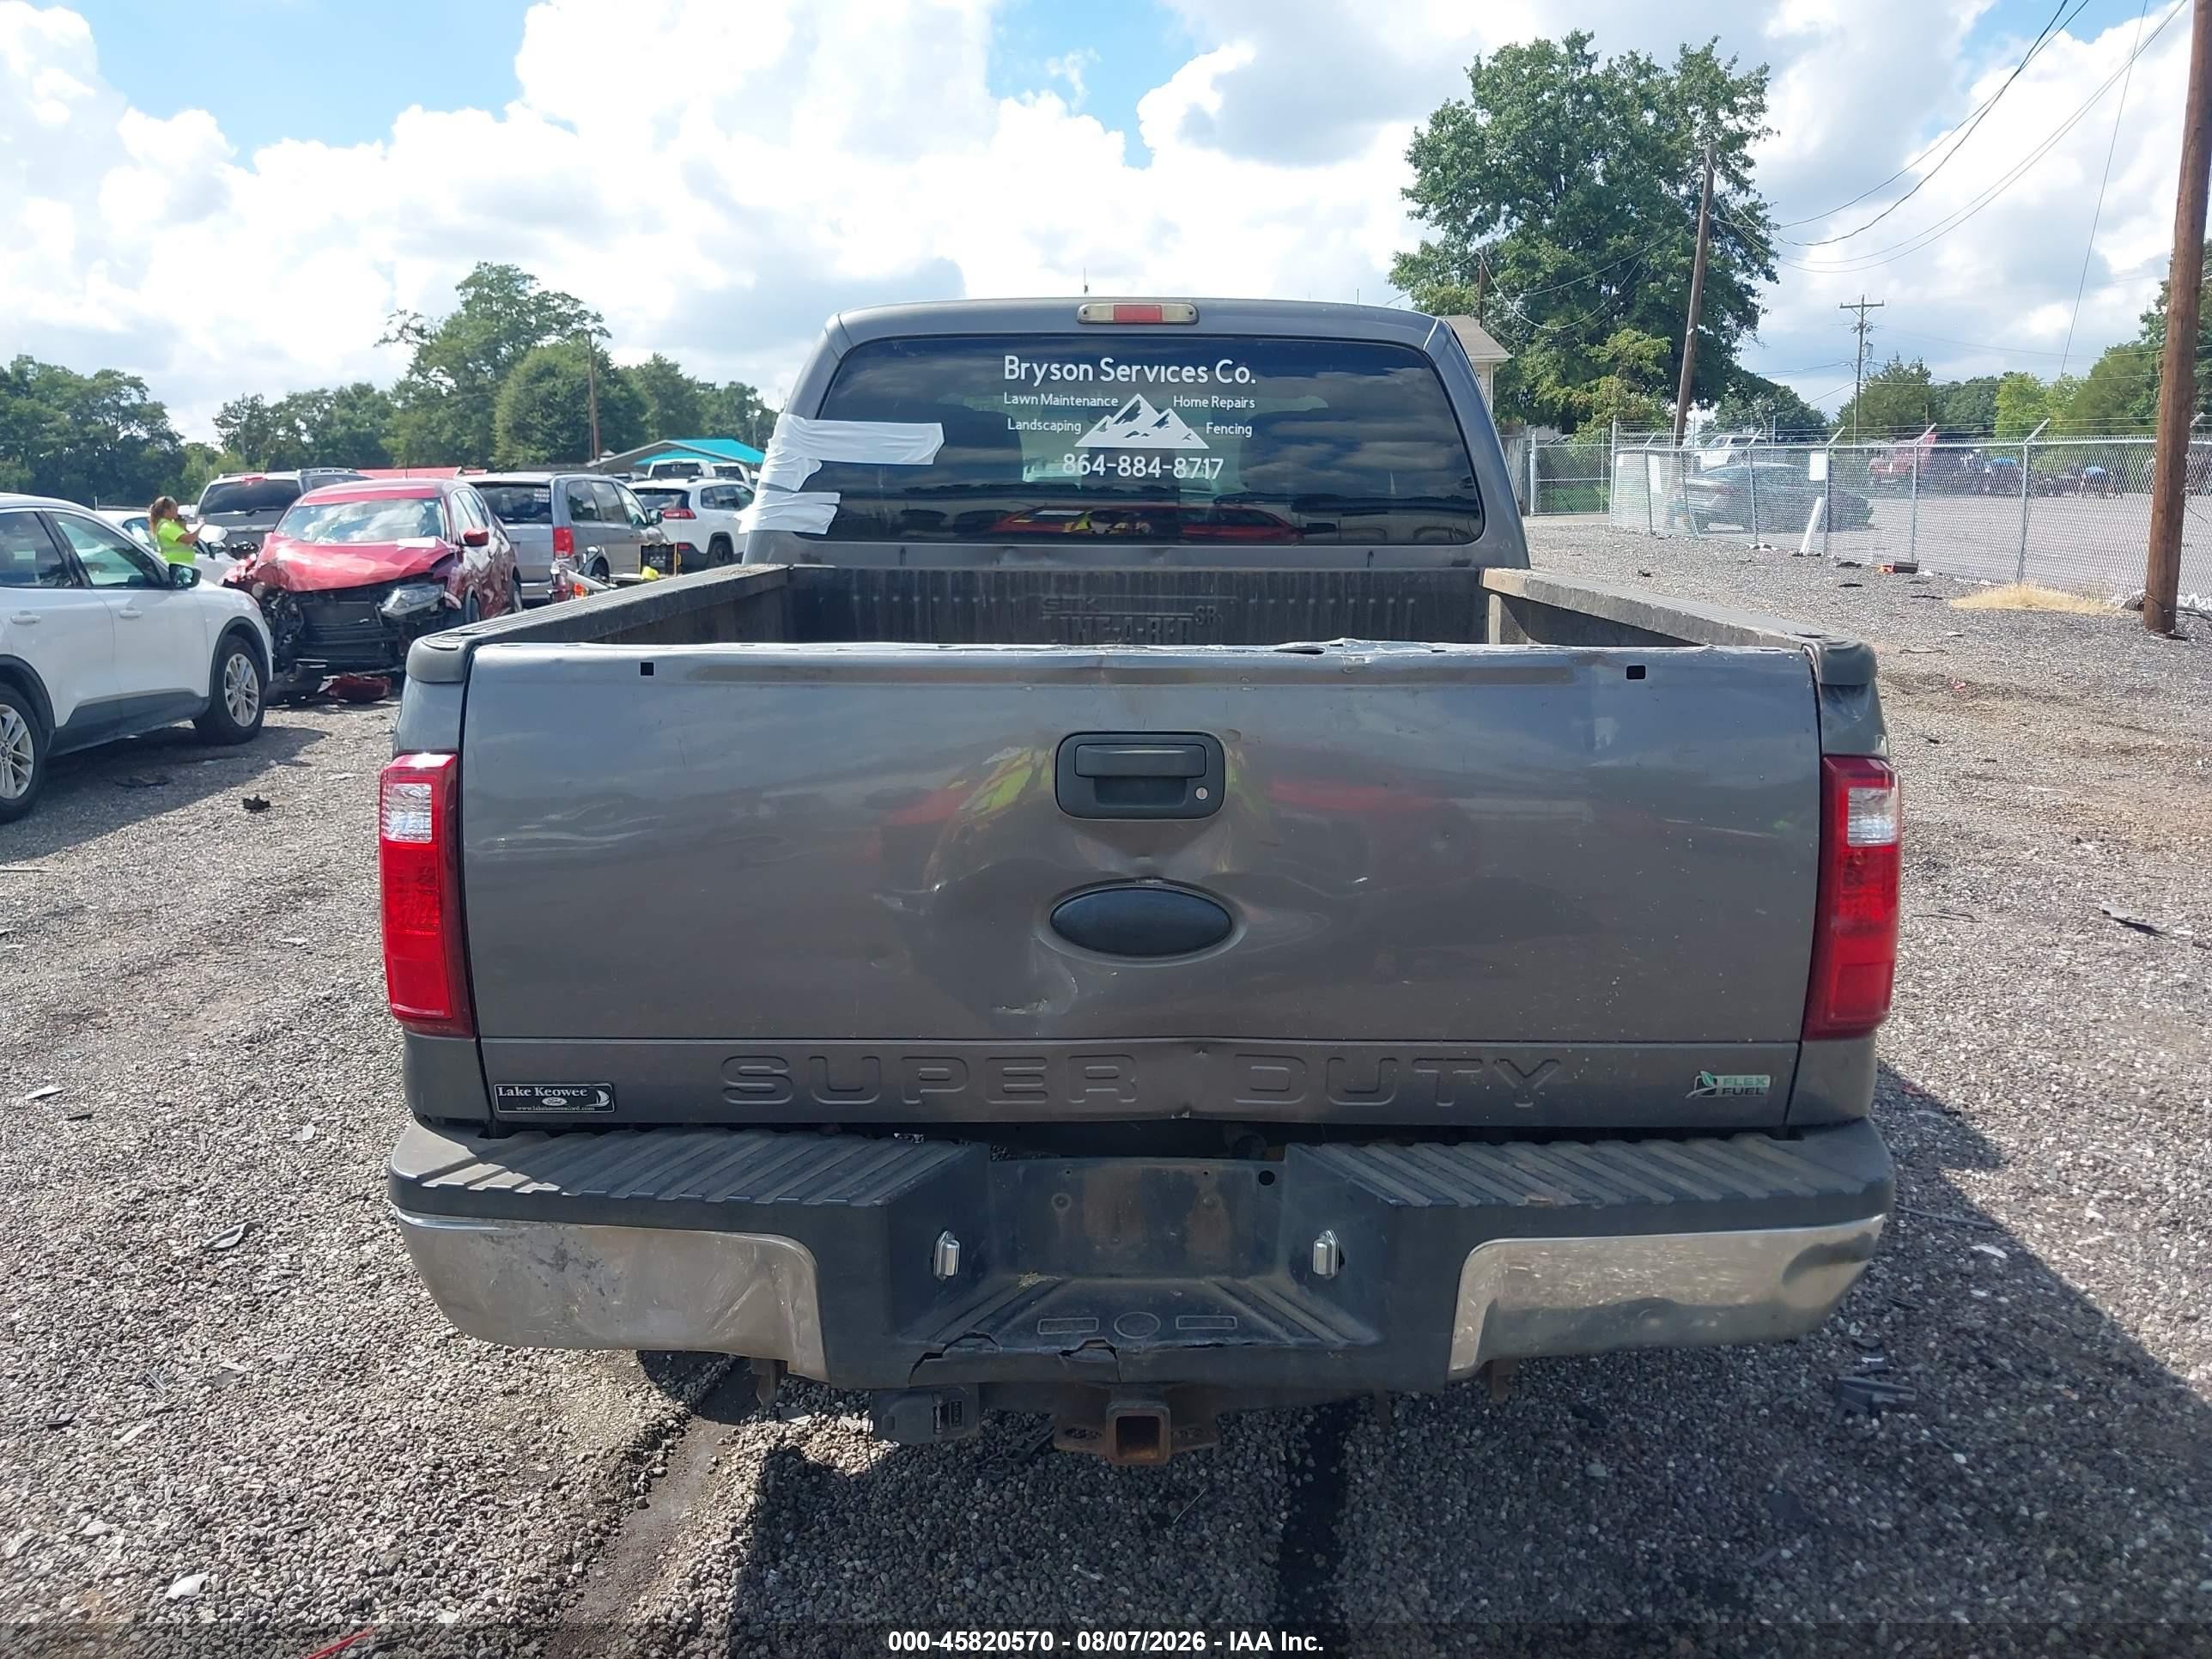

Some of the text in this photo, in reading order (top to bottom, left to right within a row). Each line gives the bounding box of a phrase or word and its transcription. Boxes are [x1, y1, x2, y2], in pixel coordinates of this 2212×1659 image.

[1004, 356, 1256, 386] Bryson Services Co.
[1004, 392, 1118, 407] Lawn Maintenance
[1173, 396, 1255, 410] Home Repairs
[1007, 418, 1082, 434] Landscaping
[1206, 422, 1252, 438] Fencing
[1062, 453, 1224, 479] 864-884-8717
[719, 1054, 1562, 1108] SUPER DUTY
[1723, 1078, 1766, 1086] FLEX
[497, 1086, 588, 1097] Lake Keowee
[1723, 1087, 1765, 1096] FUEL
